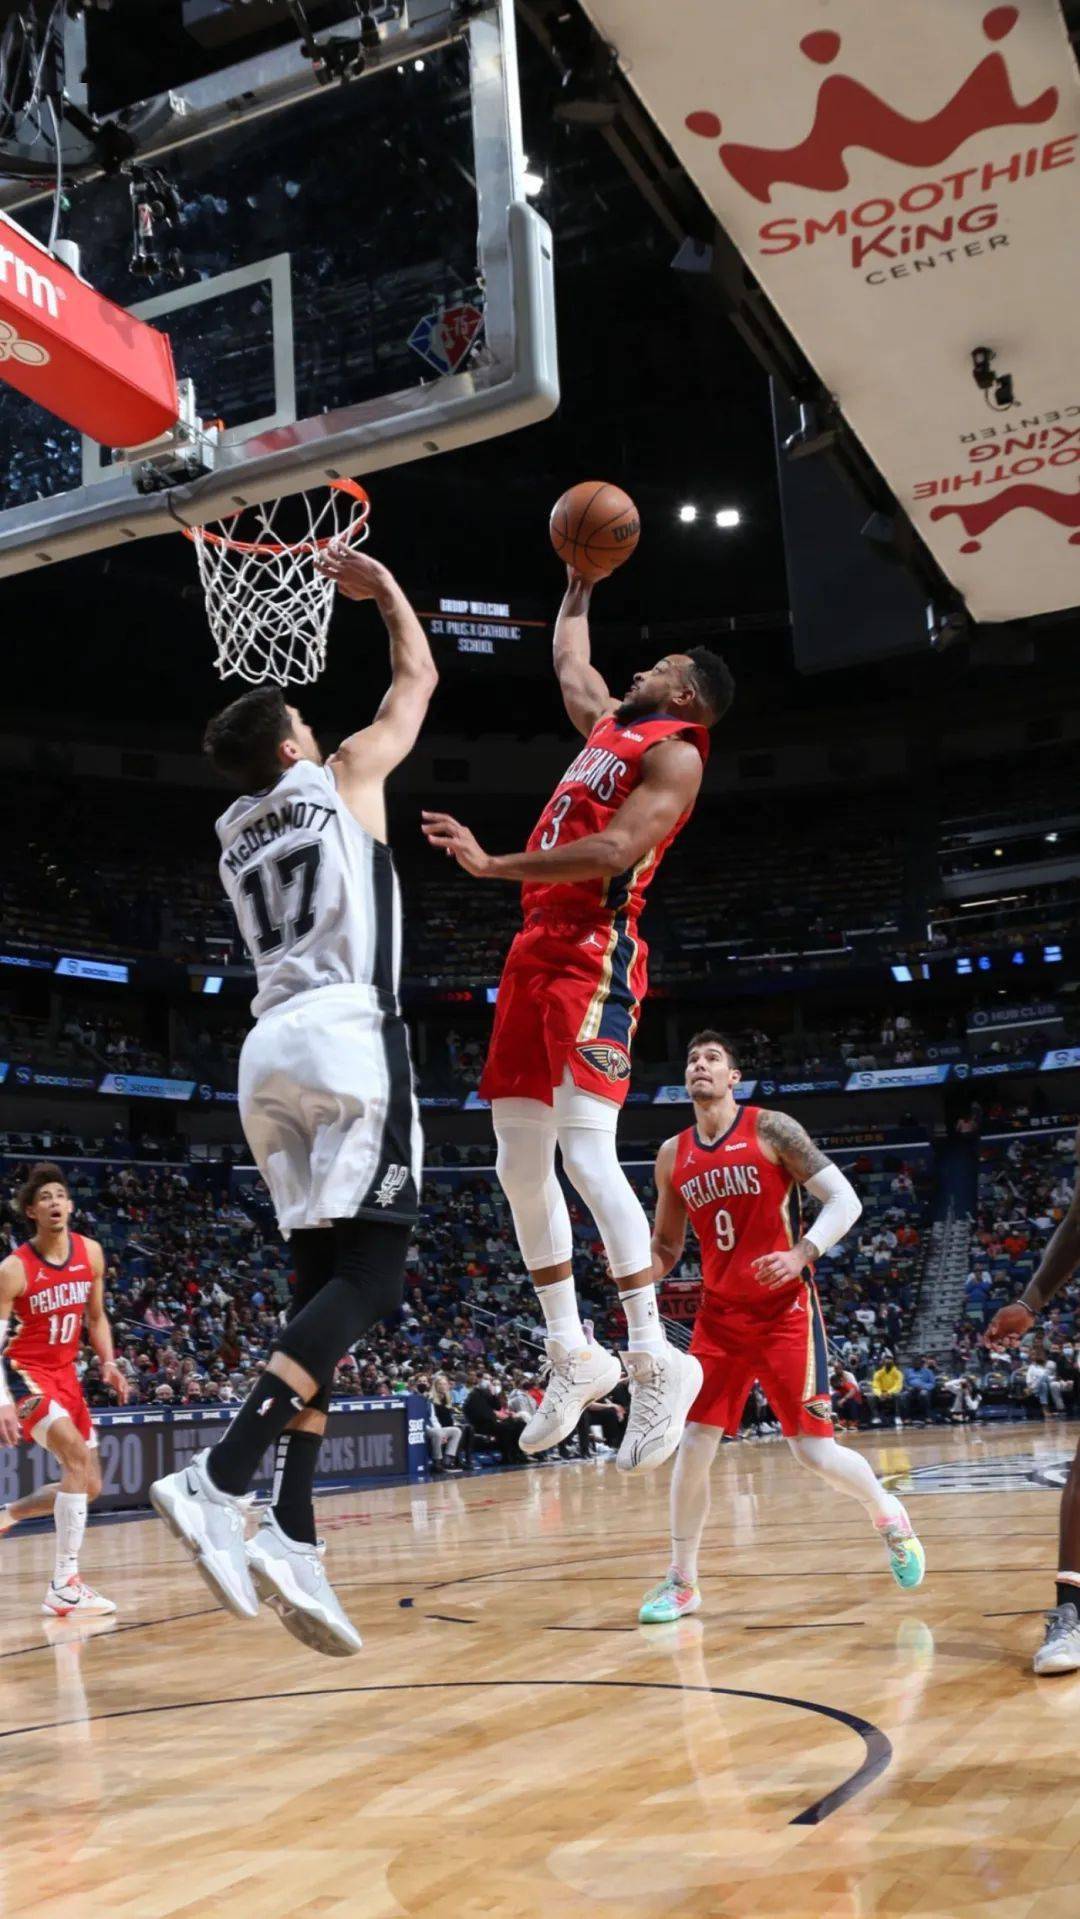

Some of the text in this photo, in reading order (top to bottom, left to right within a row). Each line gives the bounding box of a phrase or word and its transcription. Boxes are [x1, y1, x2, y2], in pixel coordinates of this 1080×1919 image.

[759, 134, 1078, 255] SMOOTHIE
[865, 234, 1010, 286] CENTER
[458, 638, 494, 653] SCHOOL
[224, 802, 337, 876] McDERMOTT
[540, 794, 571, 851] 3
[240, 840, 322, 956] 17
[680, 1165, 761, 1212] PELICANS
[715, 1209, 735, 1251] 9
[48, 1313, 77, 1345] 10
[358, 1434, 394, 1468] LIVE
